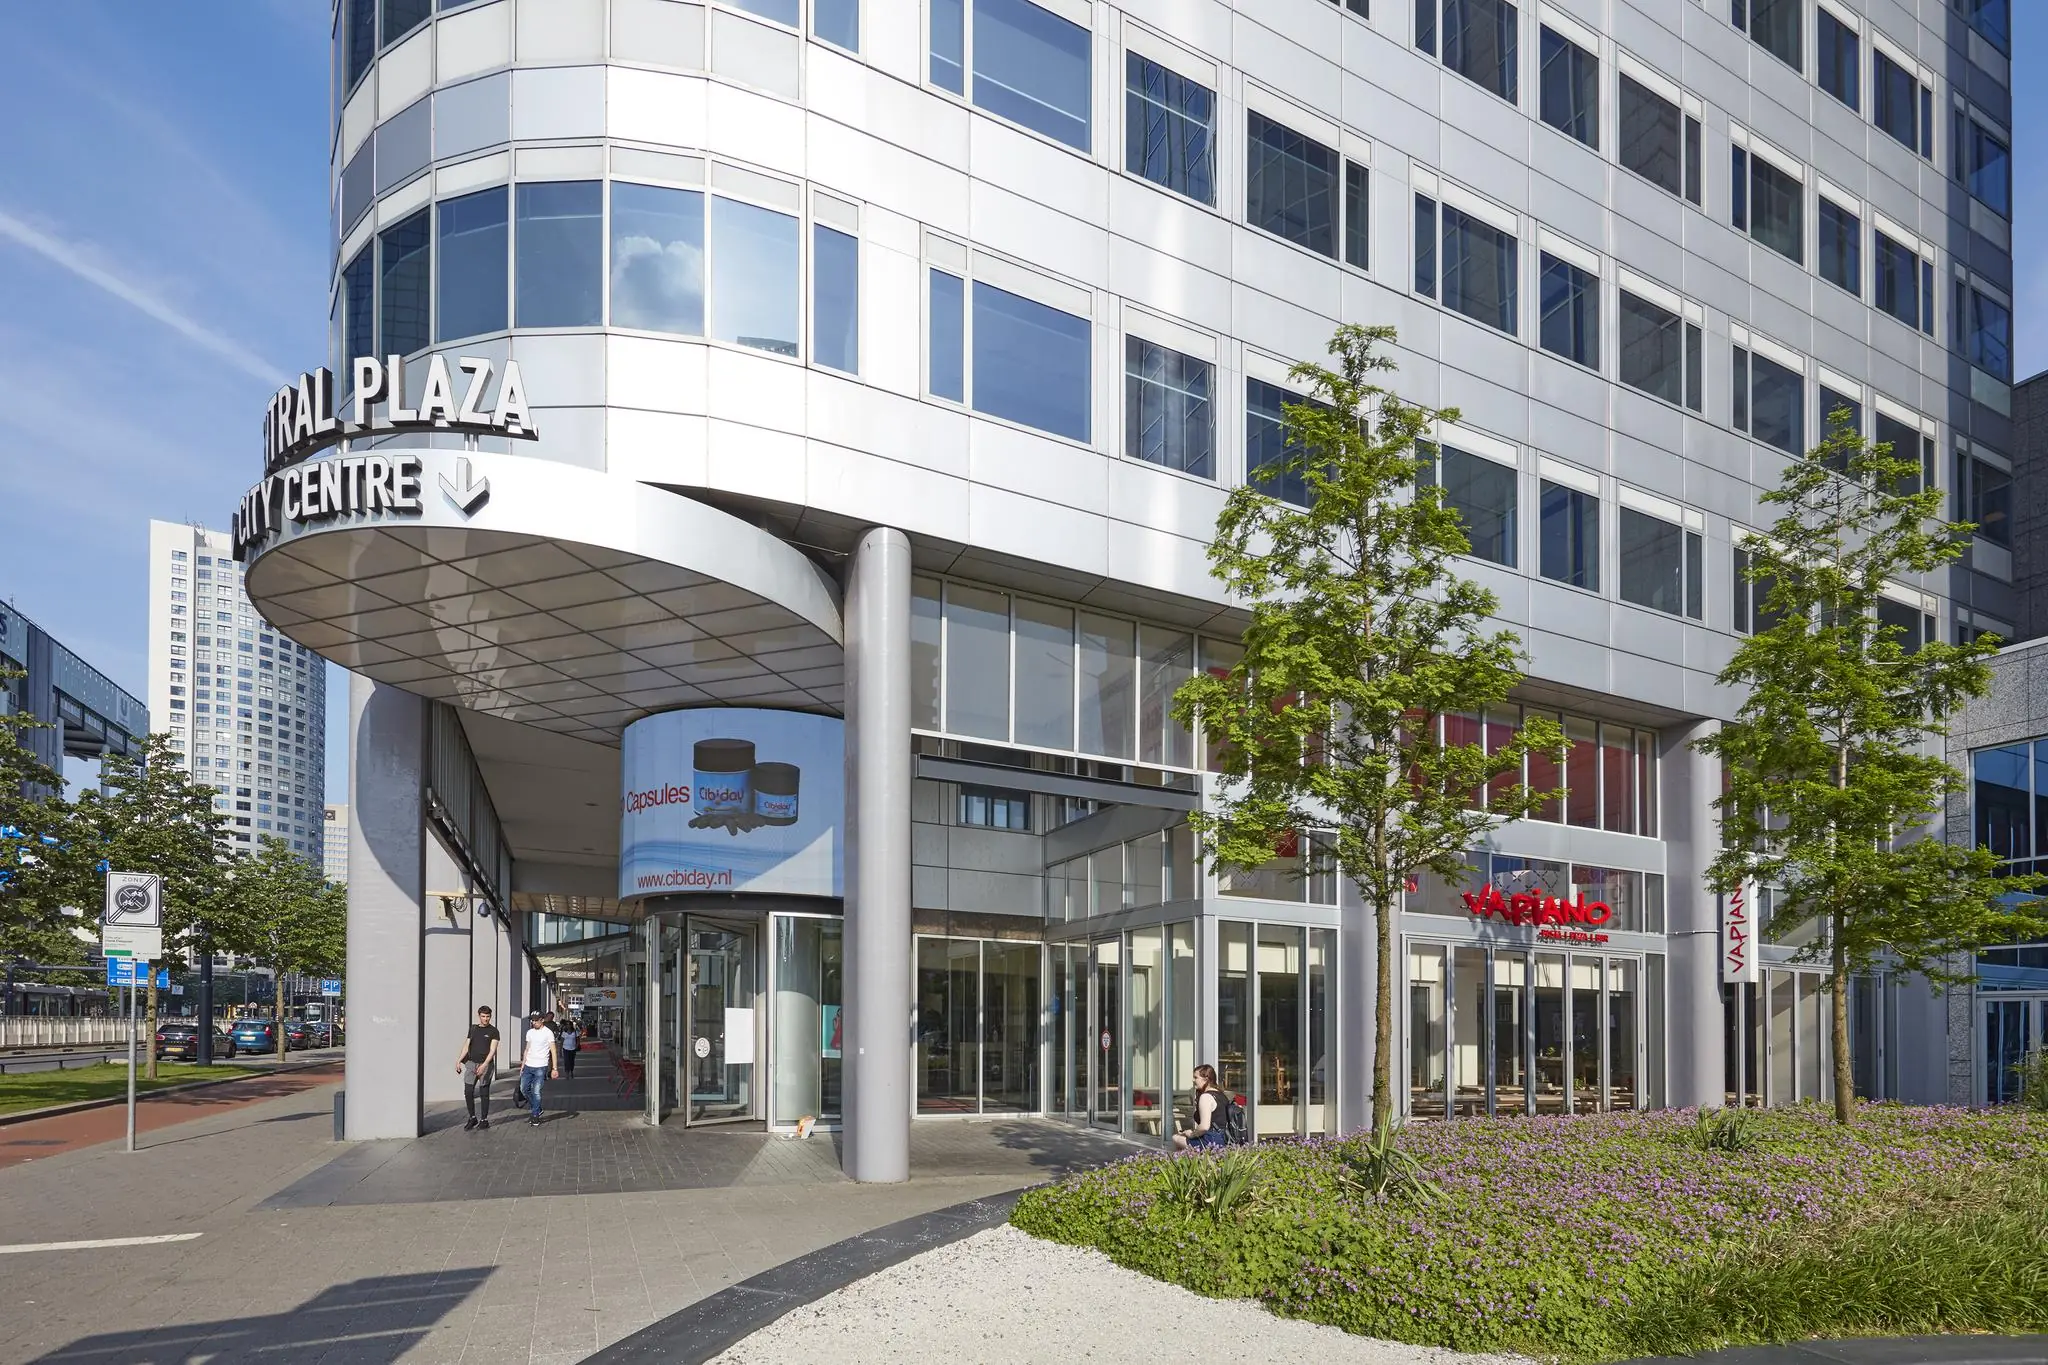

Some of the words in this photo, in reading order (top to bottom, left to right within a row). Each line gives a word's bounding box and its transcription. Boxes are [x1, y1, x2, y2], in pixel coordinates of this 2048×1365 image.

[264, 367, 343, 476] TRAL
[354, 354, 538, 440] PLAZA
[238, 475, 280, 548] CITY
[284, 455, 422, 522] CENTRE
[626, 783, 690, 814] Capsules
[699, 785, 744, 803] Cibiday
[637, 869, 732, 889] www.cibiday.nl
